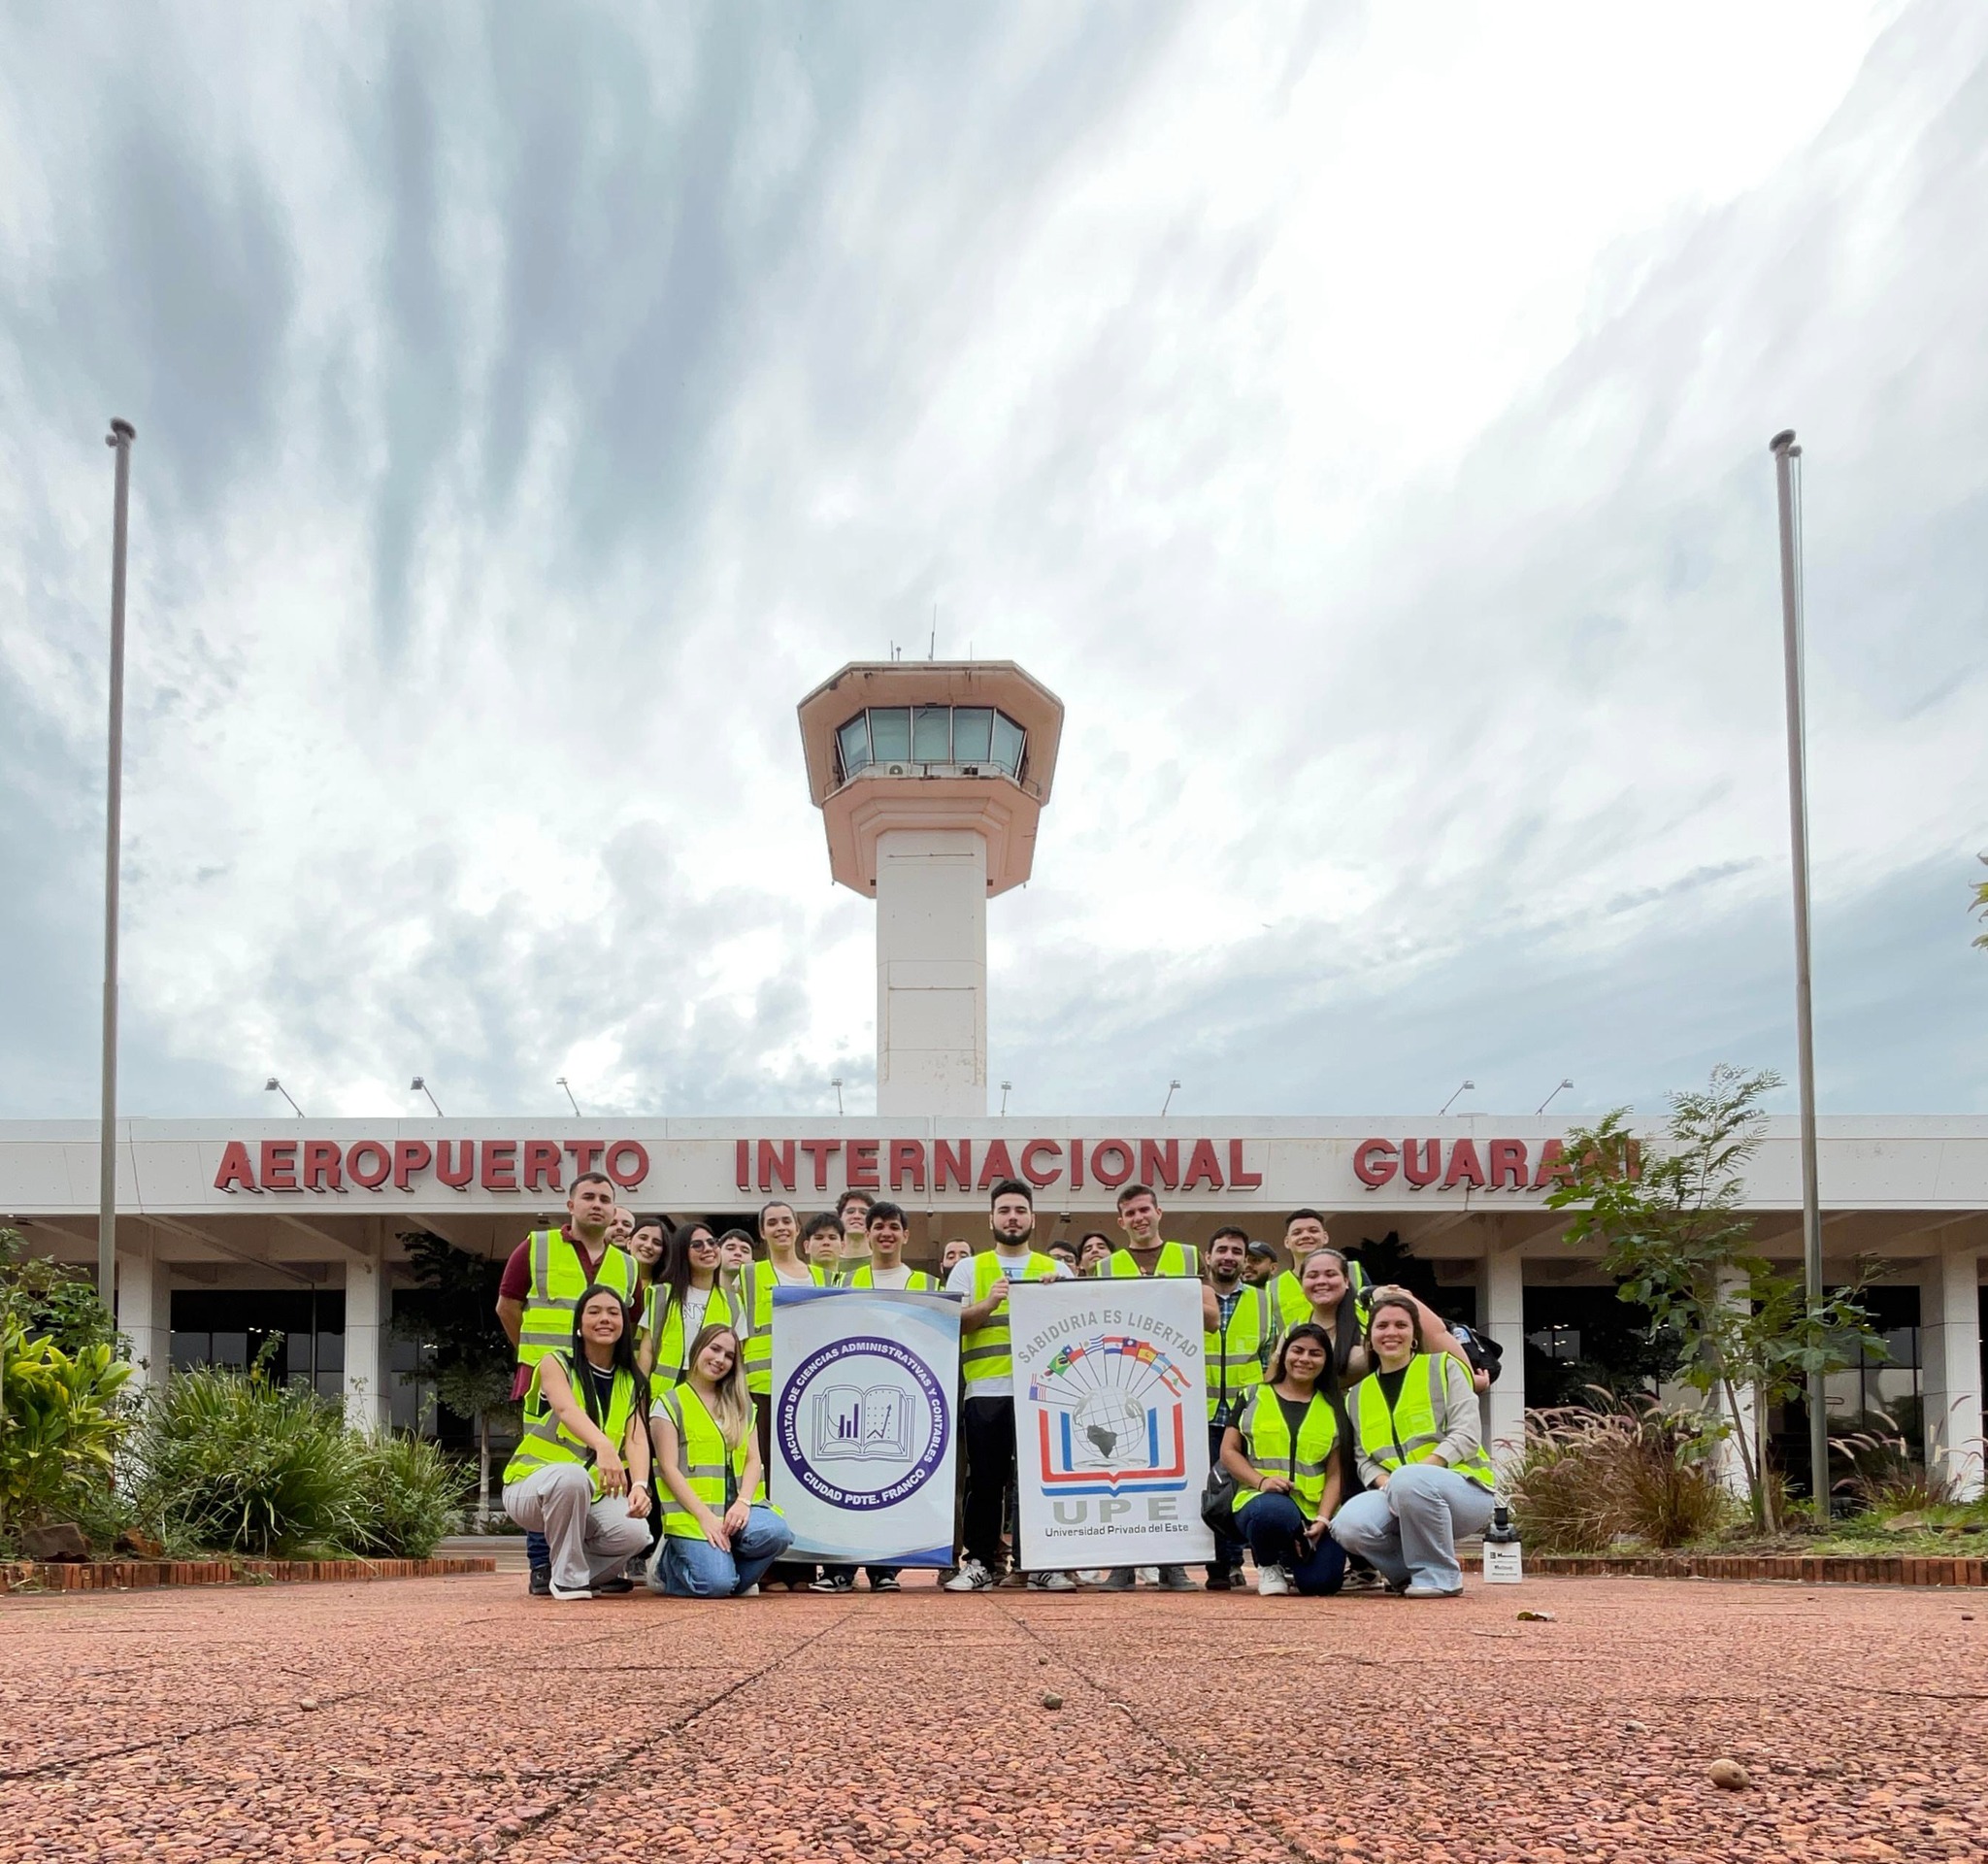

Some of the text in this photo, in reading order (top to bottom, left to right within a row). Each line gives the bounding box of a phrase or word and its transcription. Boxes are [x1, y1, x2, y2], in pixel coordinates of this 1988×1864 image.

[214, 1140, 649, 1188] AEROPUERTO
[736, 1139, 1263, 1188] INTERNACIONAL
[1017, 1310, 1199, 1364] SABIDURIA ES LIBERTAD
[784, 1342, 943, 1462] FACULTAD DE CIENCIAS ADMINISTRATIVAS Y CONTABLES
[803, 1468, 926, 1505] CIUDAD PDTE. FRANCO
[1045, 1522, 1189, 1538] Universidad Privada del Este
[1053, 1497, 1178, 1525] UPE
